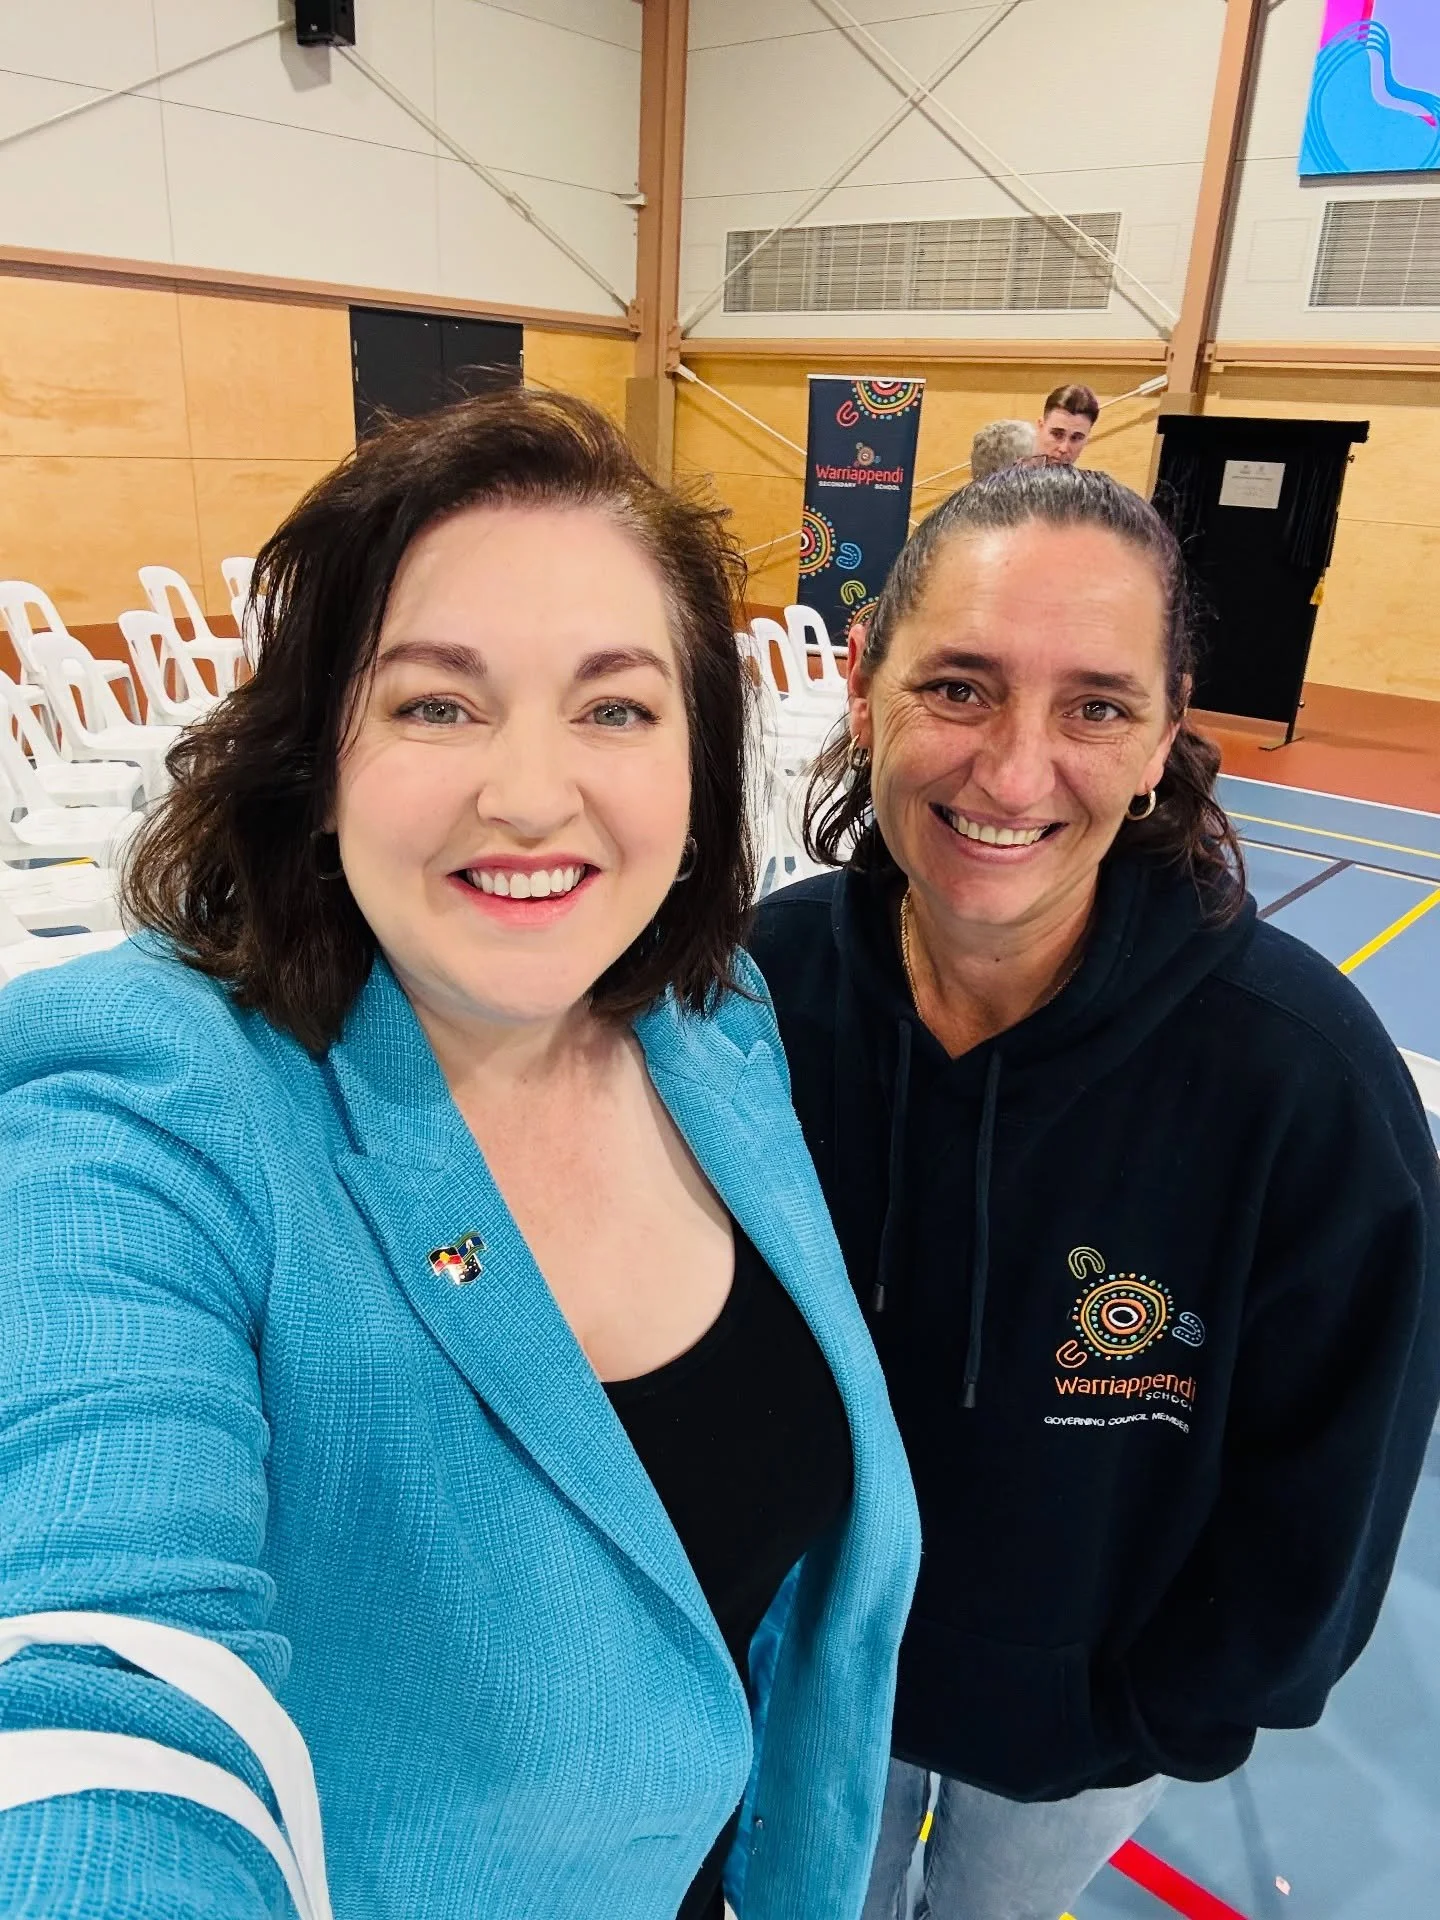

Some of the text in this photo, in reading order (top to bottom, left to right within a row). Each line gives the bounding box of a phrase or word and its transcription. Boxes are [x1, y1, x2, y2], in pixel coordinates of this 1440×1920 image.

[815, 464, 904, 485] Warriappendi
[1054, 1373, 1197, 1402] Warriappendi
[1044, 1412, 1190, 1434] GOVERNING COUNCIL MEMBER
